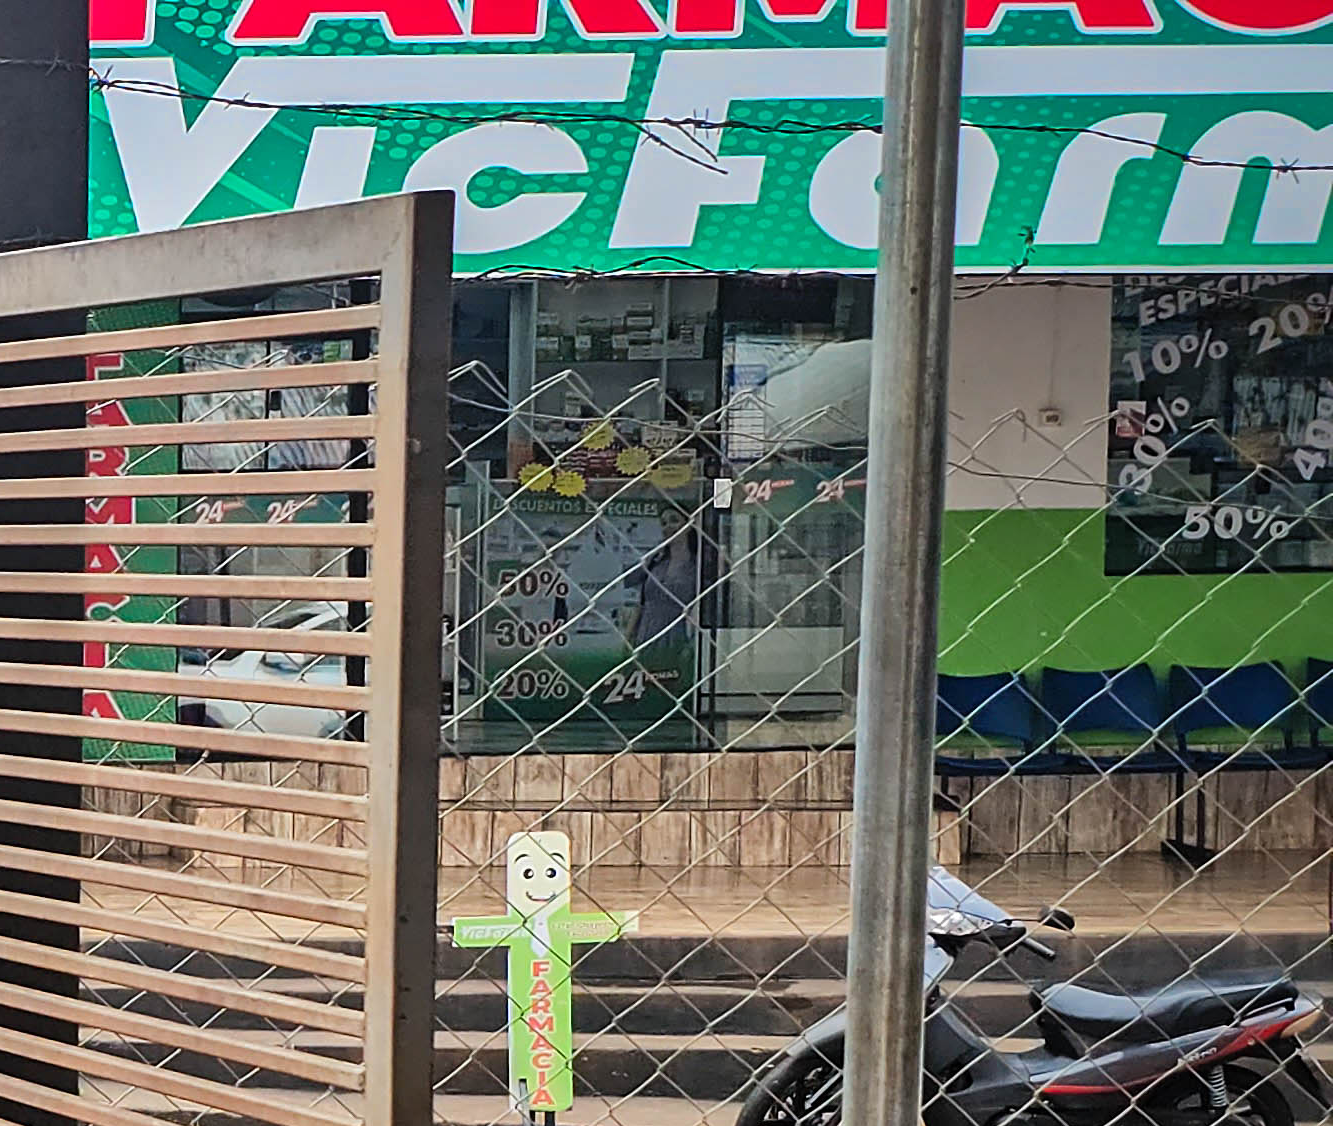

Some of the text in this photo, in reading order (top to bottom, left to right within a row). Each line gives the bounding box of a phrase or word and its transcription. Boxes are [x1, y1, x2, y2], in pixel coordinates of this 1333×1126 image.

[1139, 274, 1310, 327] ESPECIA
[1122, 328, 1229, 382] 10%
[493, 499, 658, 516] DSCUENTOS ESECIALES
[744, 479, 772, 504] 24
[1182, 505, 1290, 540] 50%
[498, 569, 569, 598] 50%
[495, 619, 569, 648] 30%
[494, 669, 569, 699] 20%
[602, 670, 647, 705] 24
[529, 960, 555, 1106] FARMACIA
